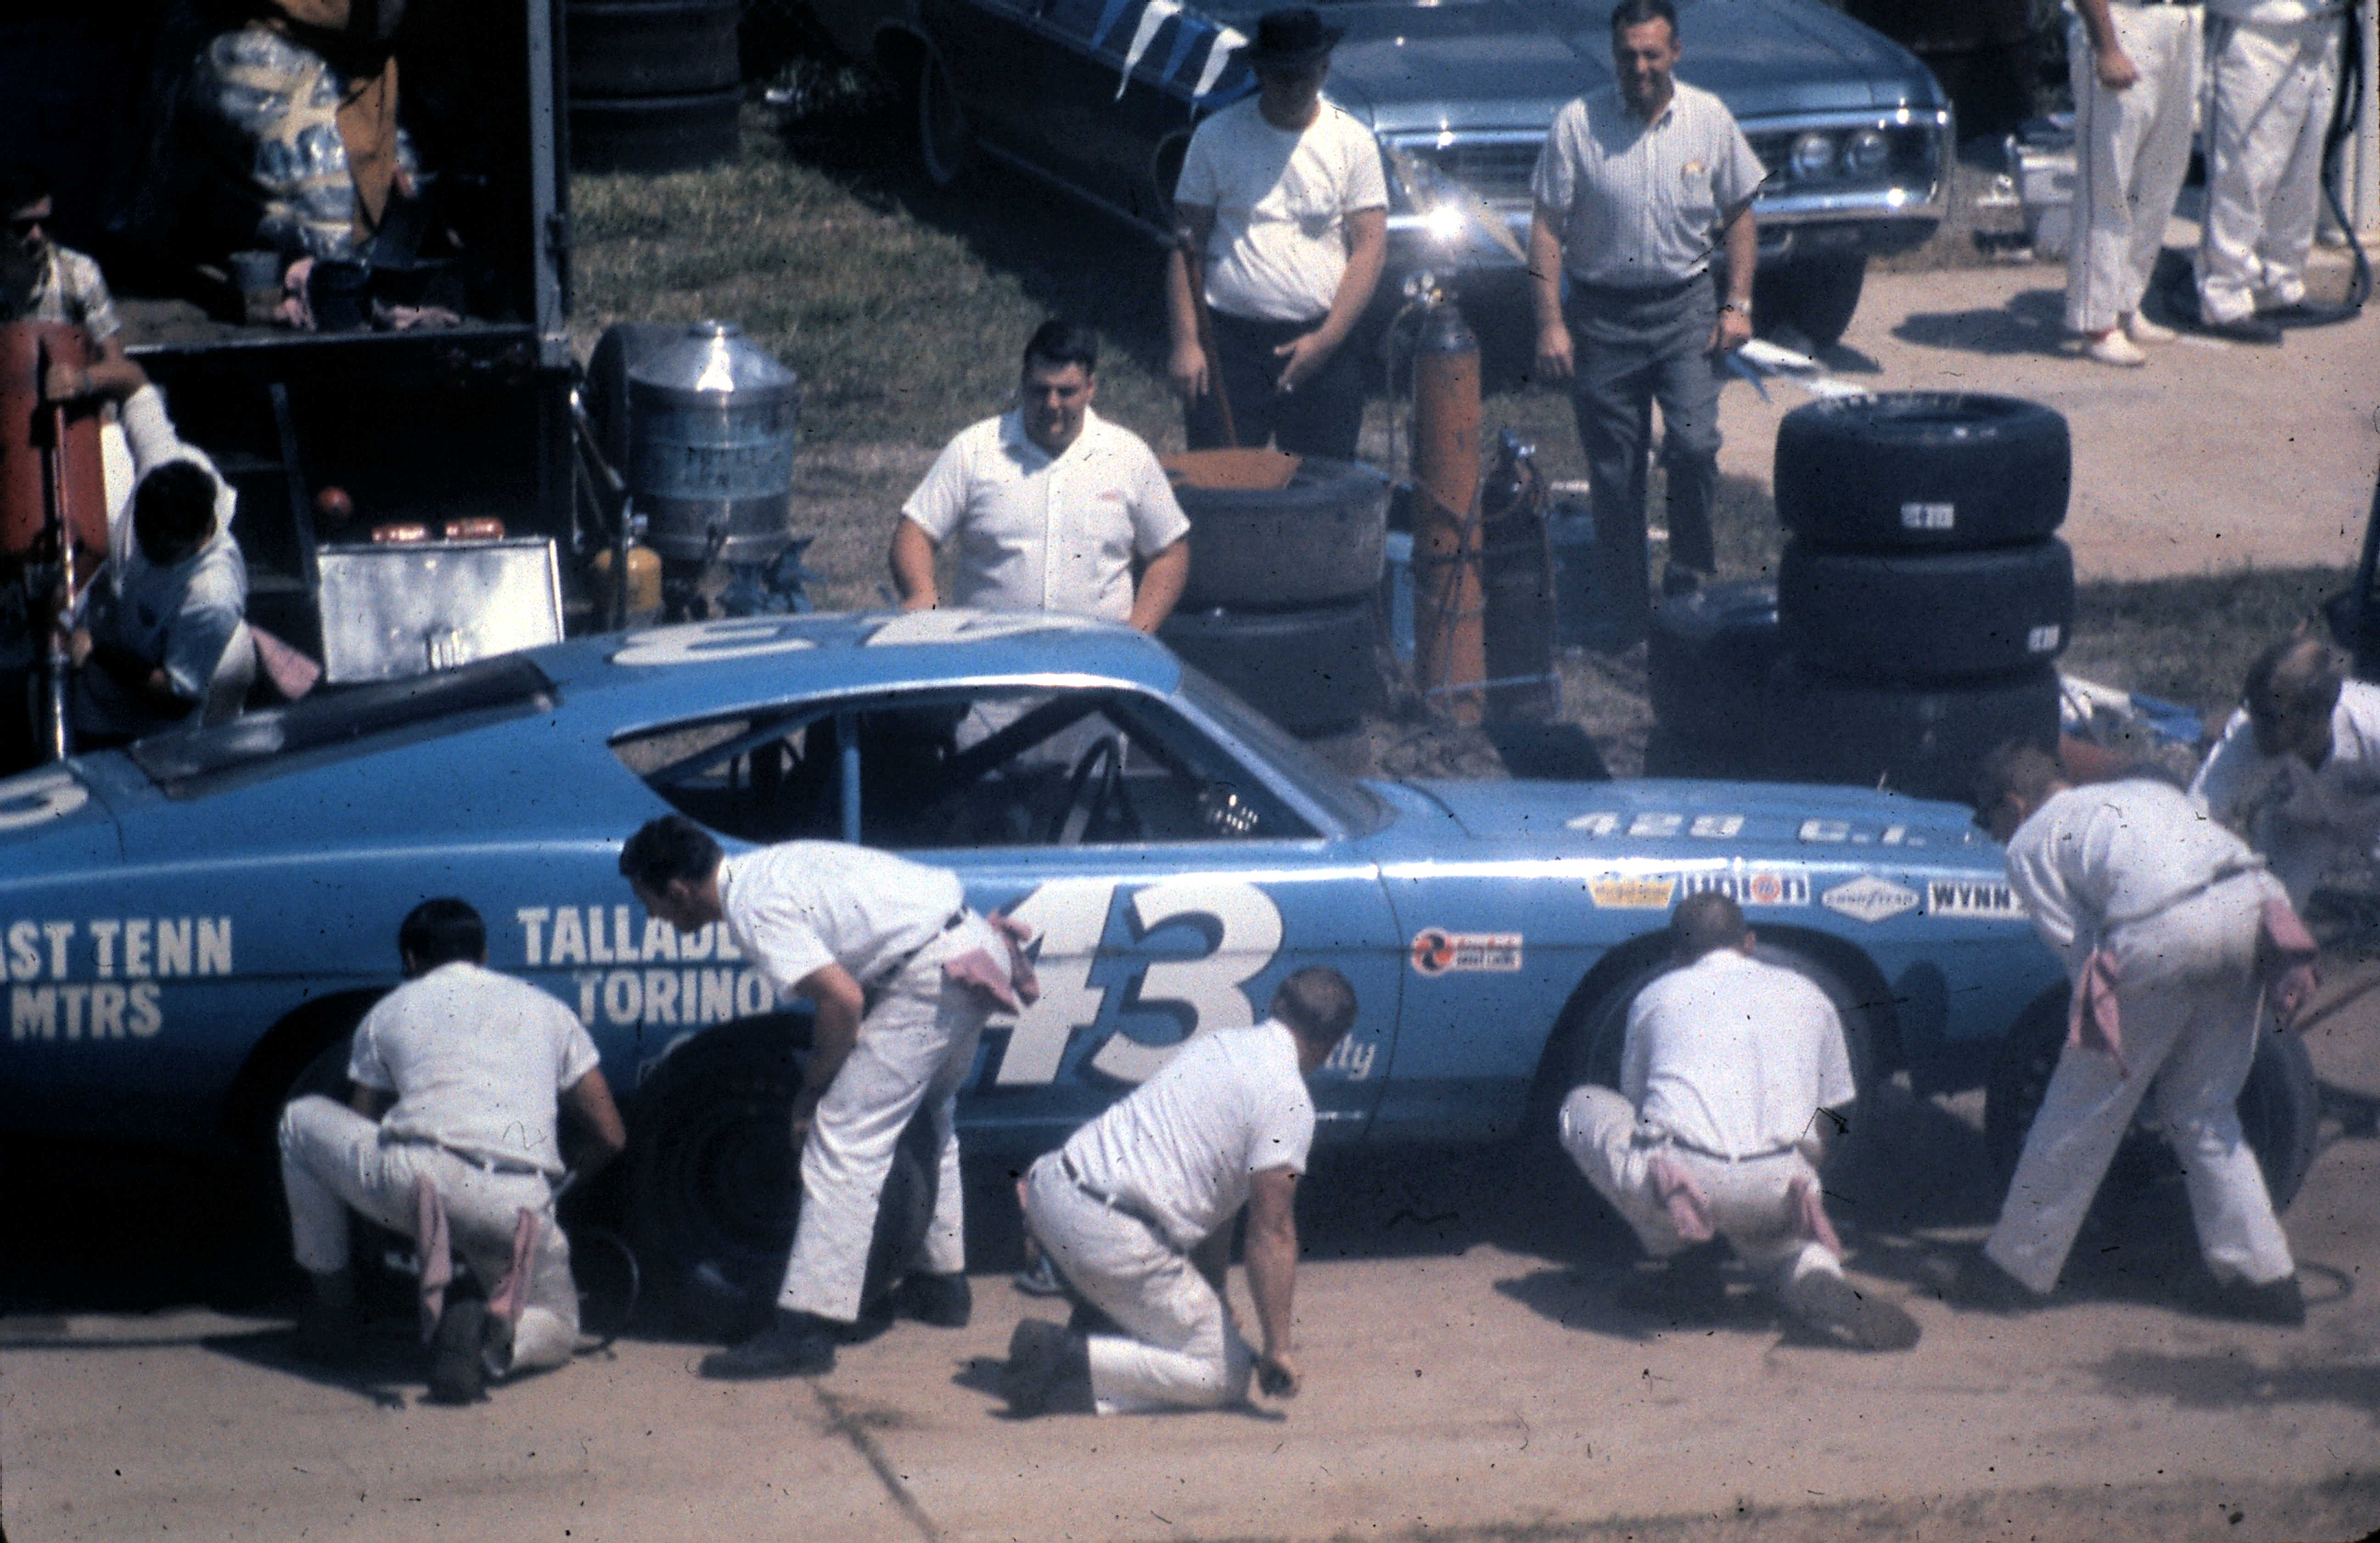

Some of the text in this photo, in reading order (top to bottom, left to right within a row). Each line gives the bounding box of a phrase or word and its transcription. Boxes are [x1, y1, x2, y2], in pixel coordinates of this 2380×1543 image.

[1931, 884, 2012, 909] WYNN
[90, 918, 232, 978] TENN
[11, 981, 162, 1040] MTRS
[573, 967, 775, 1025] TORINO
[986, 883, 1284, 1085] 43
